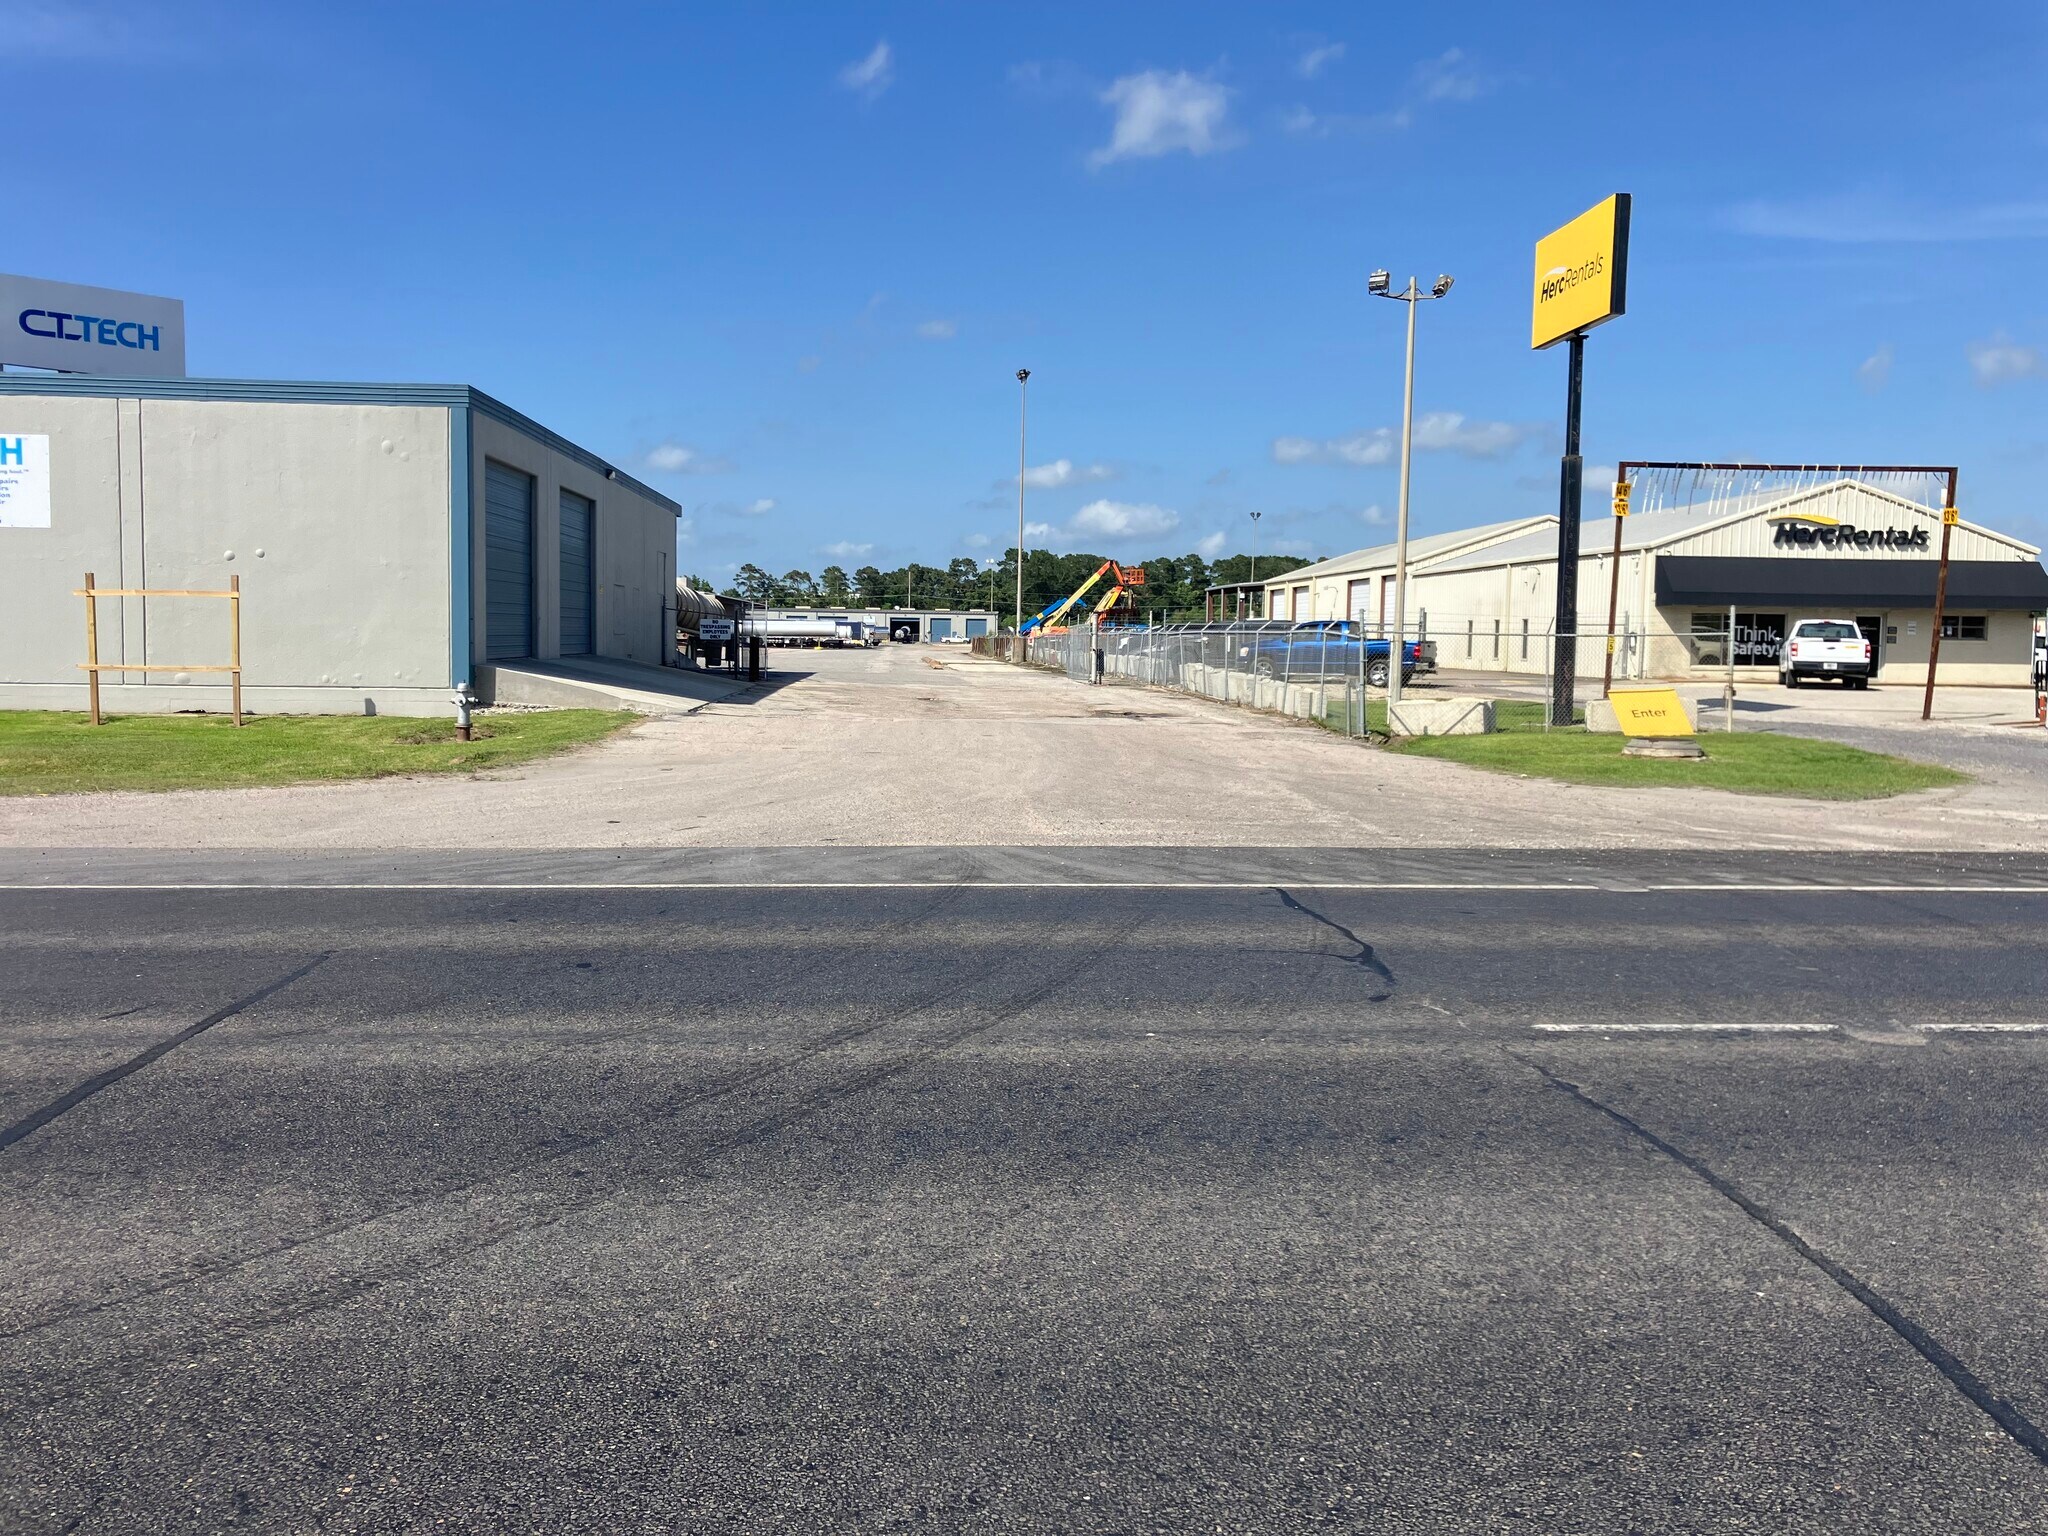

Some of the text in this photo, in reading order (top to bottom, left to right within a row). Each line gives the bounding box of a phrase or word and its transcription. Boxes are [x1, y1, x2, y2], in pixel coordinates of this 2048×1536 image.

[1540, 252, 1604, 304] HercRentals
[1774, 522, 1931, 549] HercRentals
[1734, 625, 1777, 642] Think
[1733, 641, 1780, 658] Safety!
[1631, 709, 1668, 719] Enter
